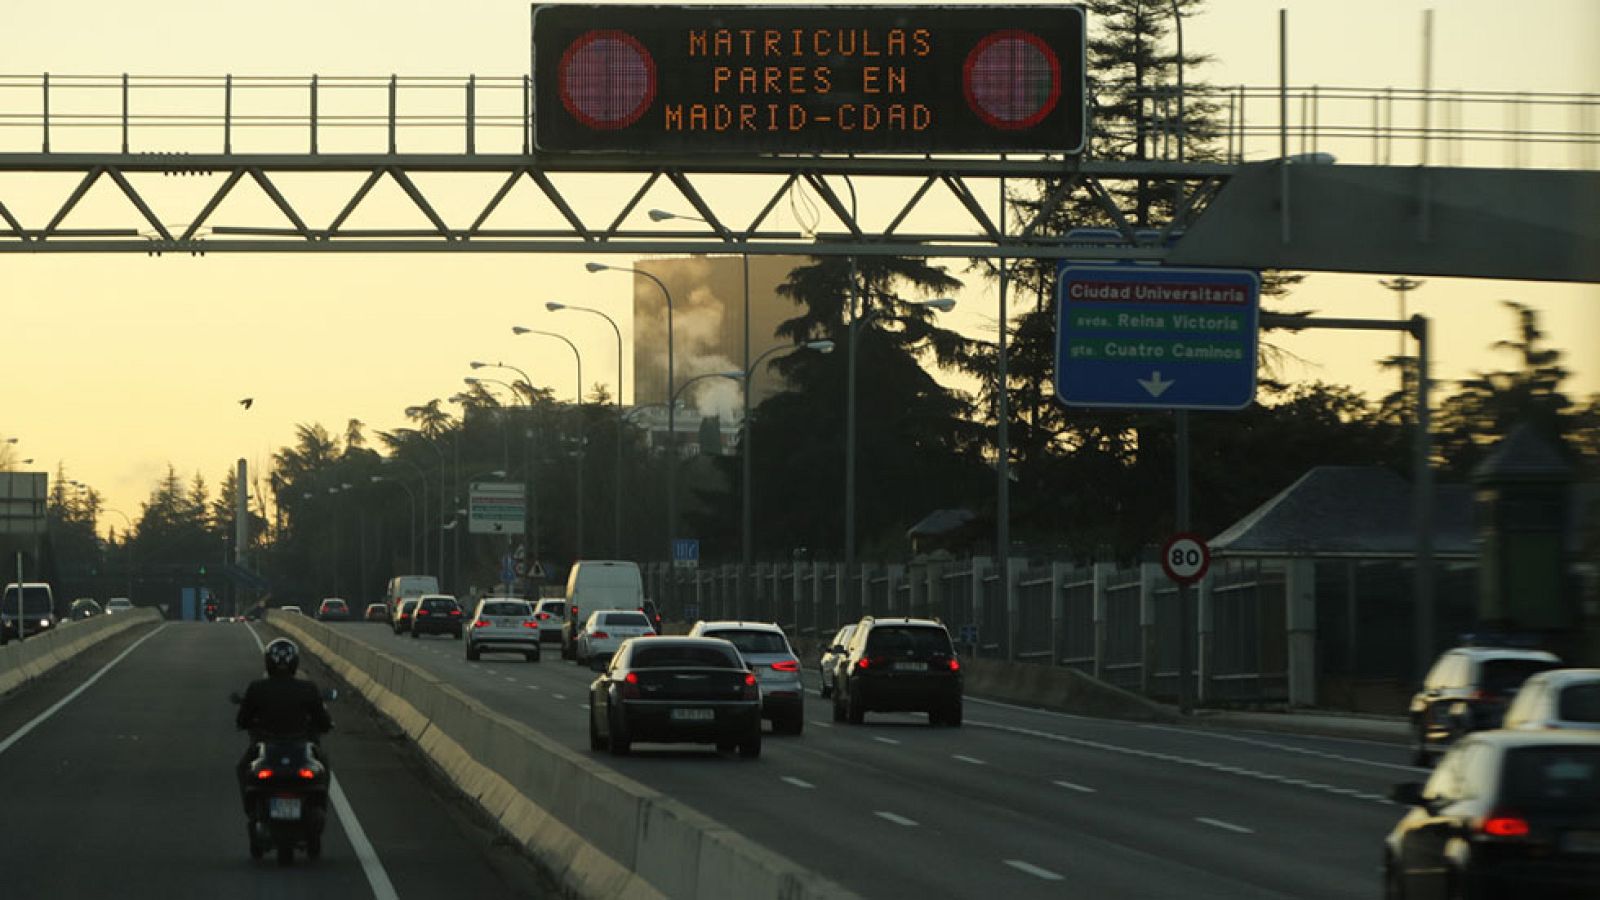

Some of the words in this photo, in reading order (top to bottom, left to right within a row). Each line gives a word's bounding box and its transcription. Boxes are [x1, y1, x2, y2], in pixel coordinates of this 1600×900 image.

[689, 28, 932, 57] MATRICULAS
[713, 66, 833, 94] PARES
[862, 66, 907, 94] EN
[665, 103, 932, 131] MADRID-CDAD
[1070, 283, 1131, 299] Ciudad
[1135, 285, 1245, 302] Universitaria
[1118, 313, 1165, 328] Reina
[1172, 314, 1239, 331] Victoria
[1104, 342, 1164, 357] Cuatro
[1171, 343, 1243, 360] Caminos
[1172, 549, 1199, 566] 80
